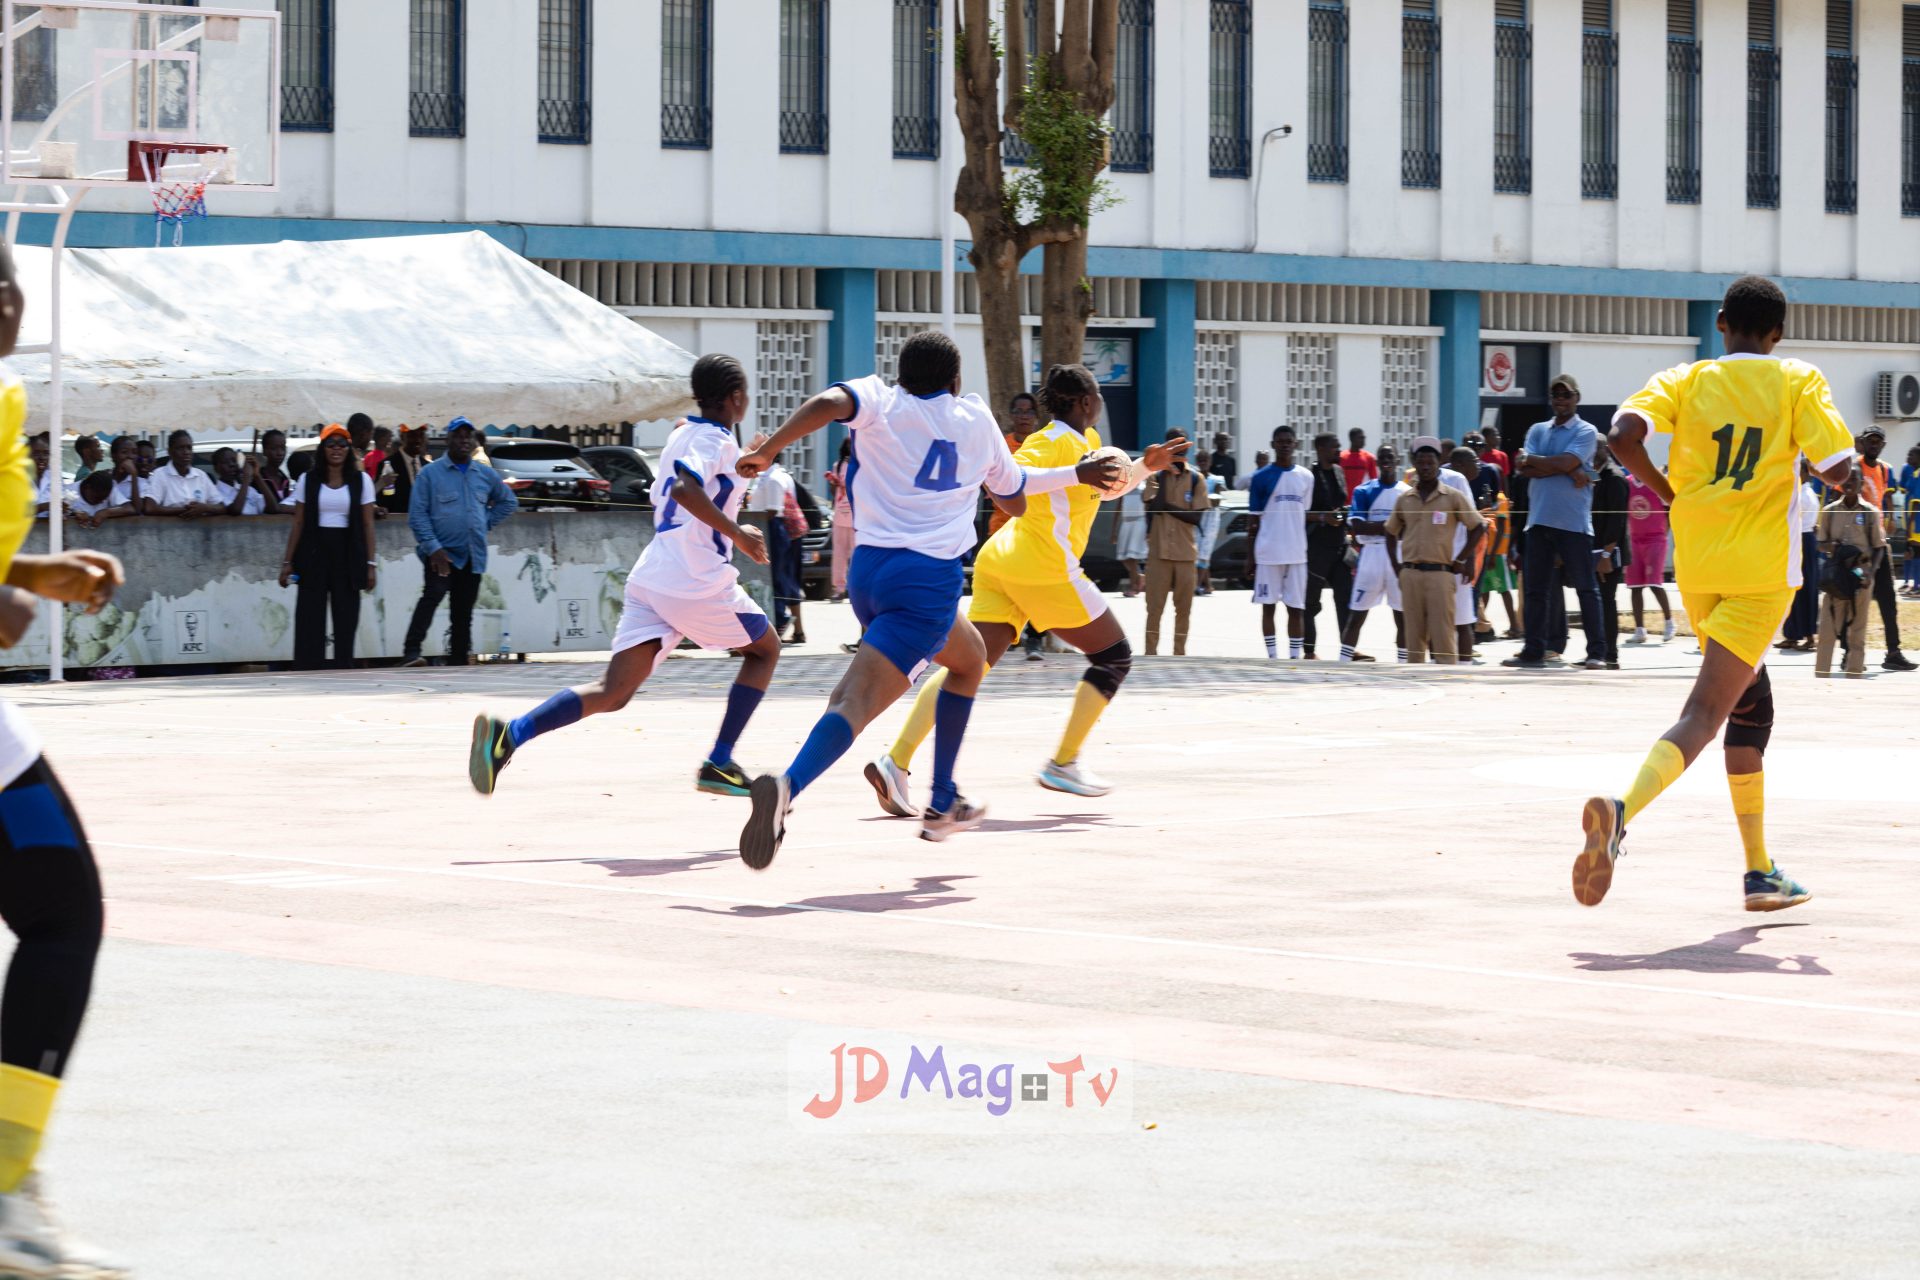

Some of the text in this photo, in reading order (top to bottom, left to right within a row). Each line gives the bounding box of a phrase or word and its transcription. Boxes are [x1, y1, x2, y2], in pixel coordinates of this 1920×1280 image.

[1708, 423, 1764, 491] 14
[913, 438, 963, 493] 4
[1357, 589, 1366, 602] 7
[567, 628, 585, 637] KFC
[182, 642, 204, 652] KFC
